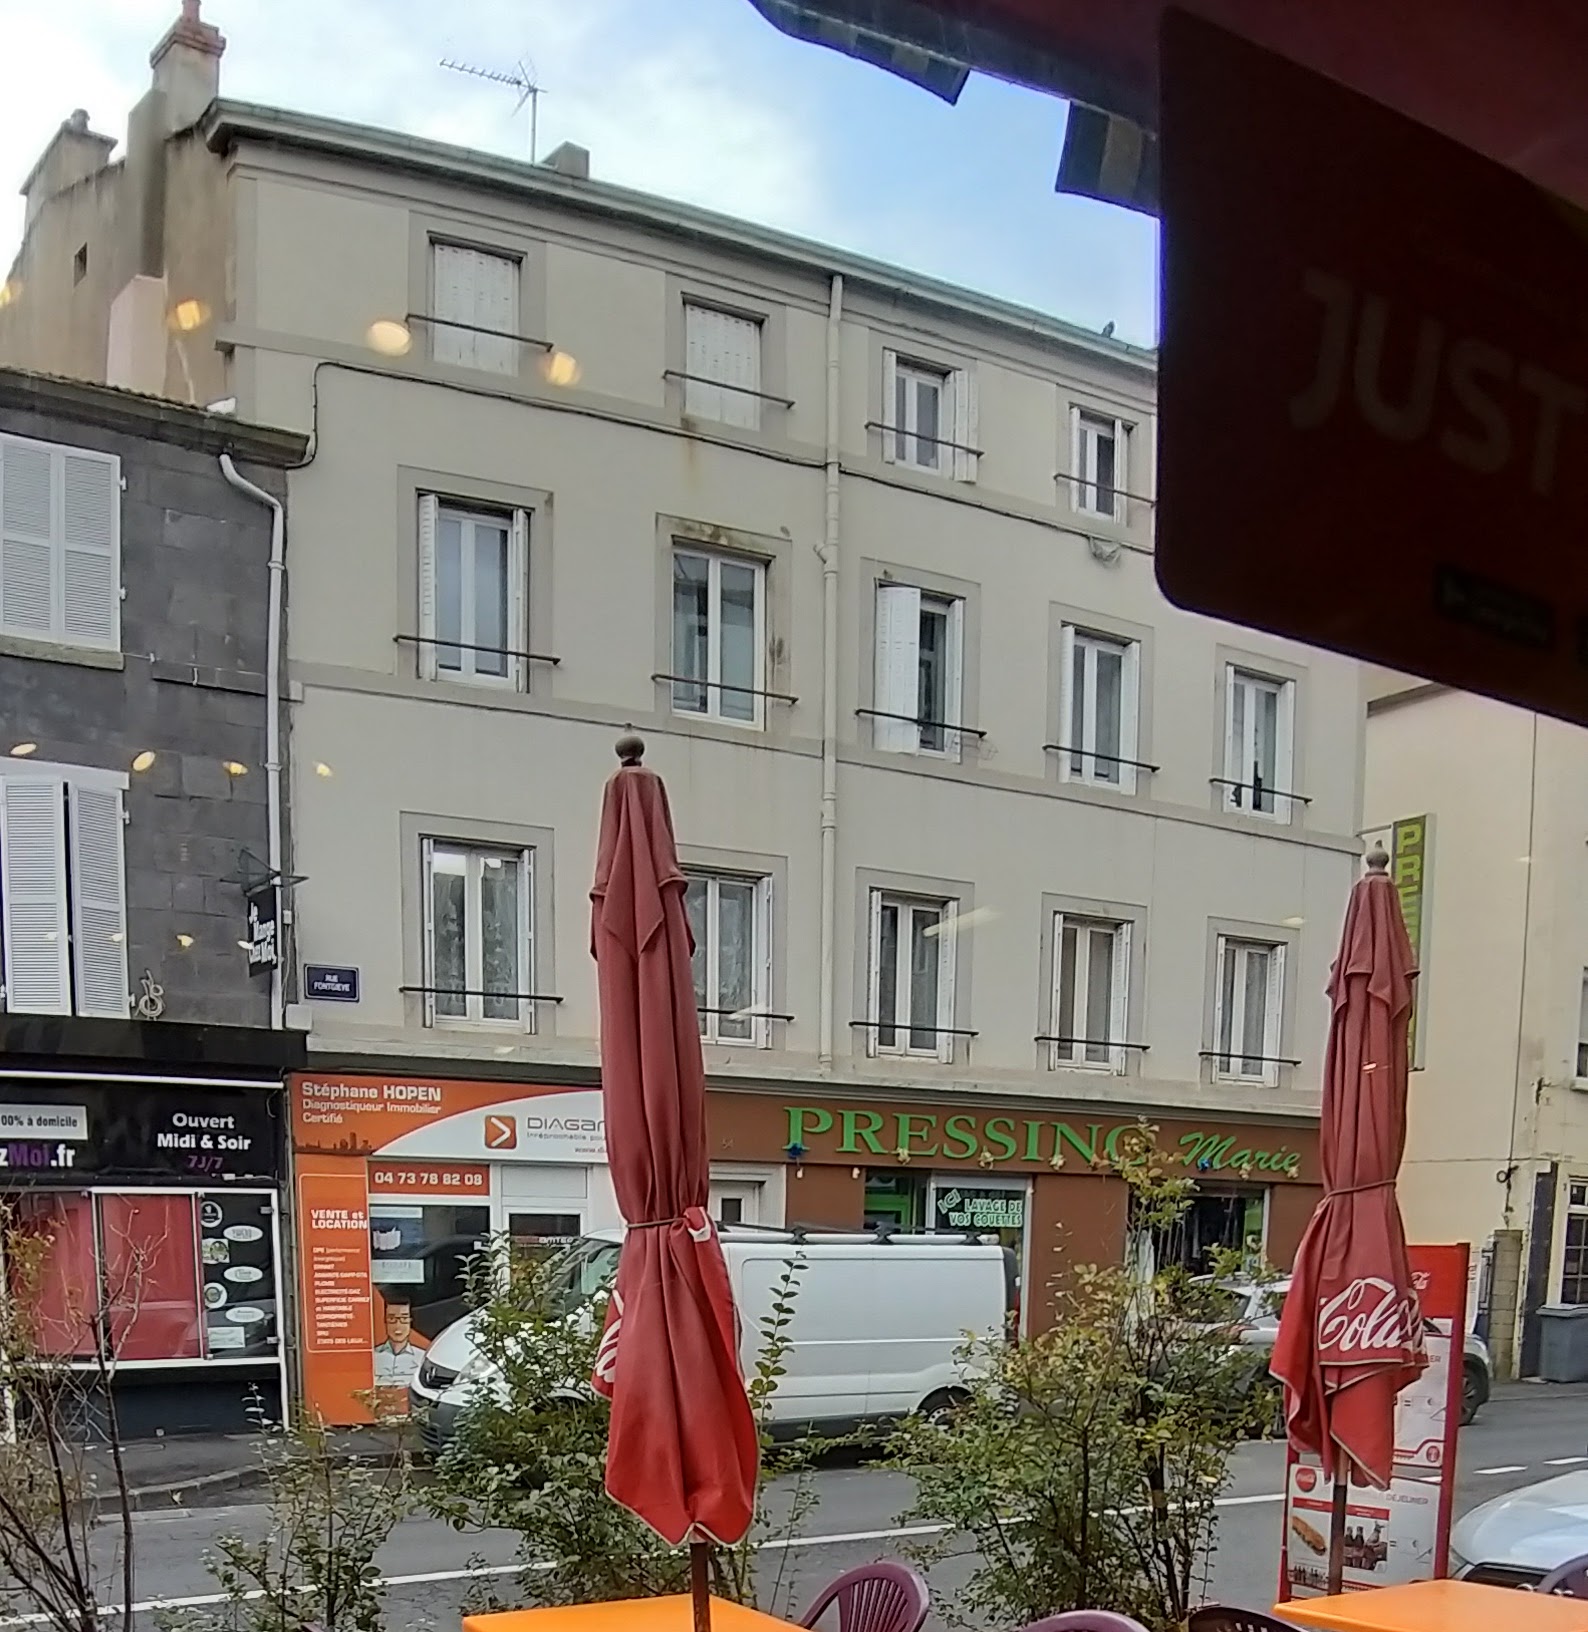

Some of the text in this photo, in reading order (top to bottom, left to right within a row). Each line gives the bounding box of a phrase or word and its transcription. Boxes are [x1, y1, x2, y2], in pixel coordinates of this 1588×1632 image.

[1288, 266, 1588, 497] JUST
[325, 974, 338, 982] RUE
[302, 1082, 441, 1101] Stéphane HOPEN
[303, 1099, 441, 1114] Diagnostiqueur Immobilier
[36, 1115, 77, 1127] domicile
[172, 1113, 235, 1129] Ouvert
[303, 1112, 343, 1124] Certifié
[157, 1133, 251, 1150] Midi & Soir
[1179, 1131, 1300, 1172] Marie
[375, 1172, 483, 1186] 04 73 78 82 08
[938, 1189, 961, 1214] ICI
[965, 1199, 1022, 1213] LAVAGE DE
[311, 1209, 364, 1219] VENTE et
[949, 1212, 1022, 1227] VOS COUETTES
[312, 1219, 368, 1229] LOCATION
